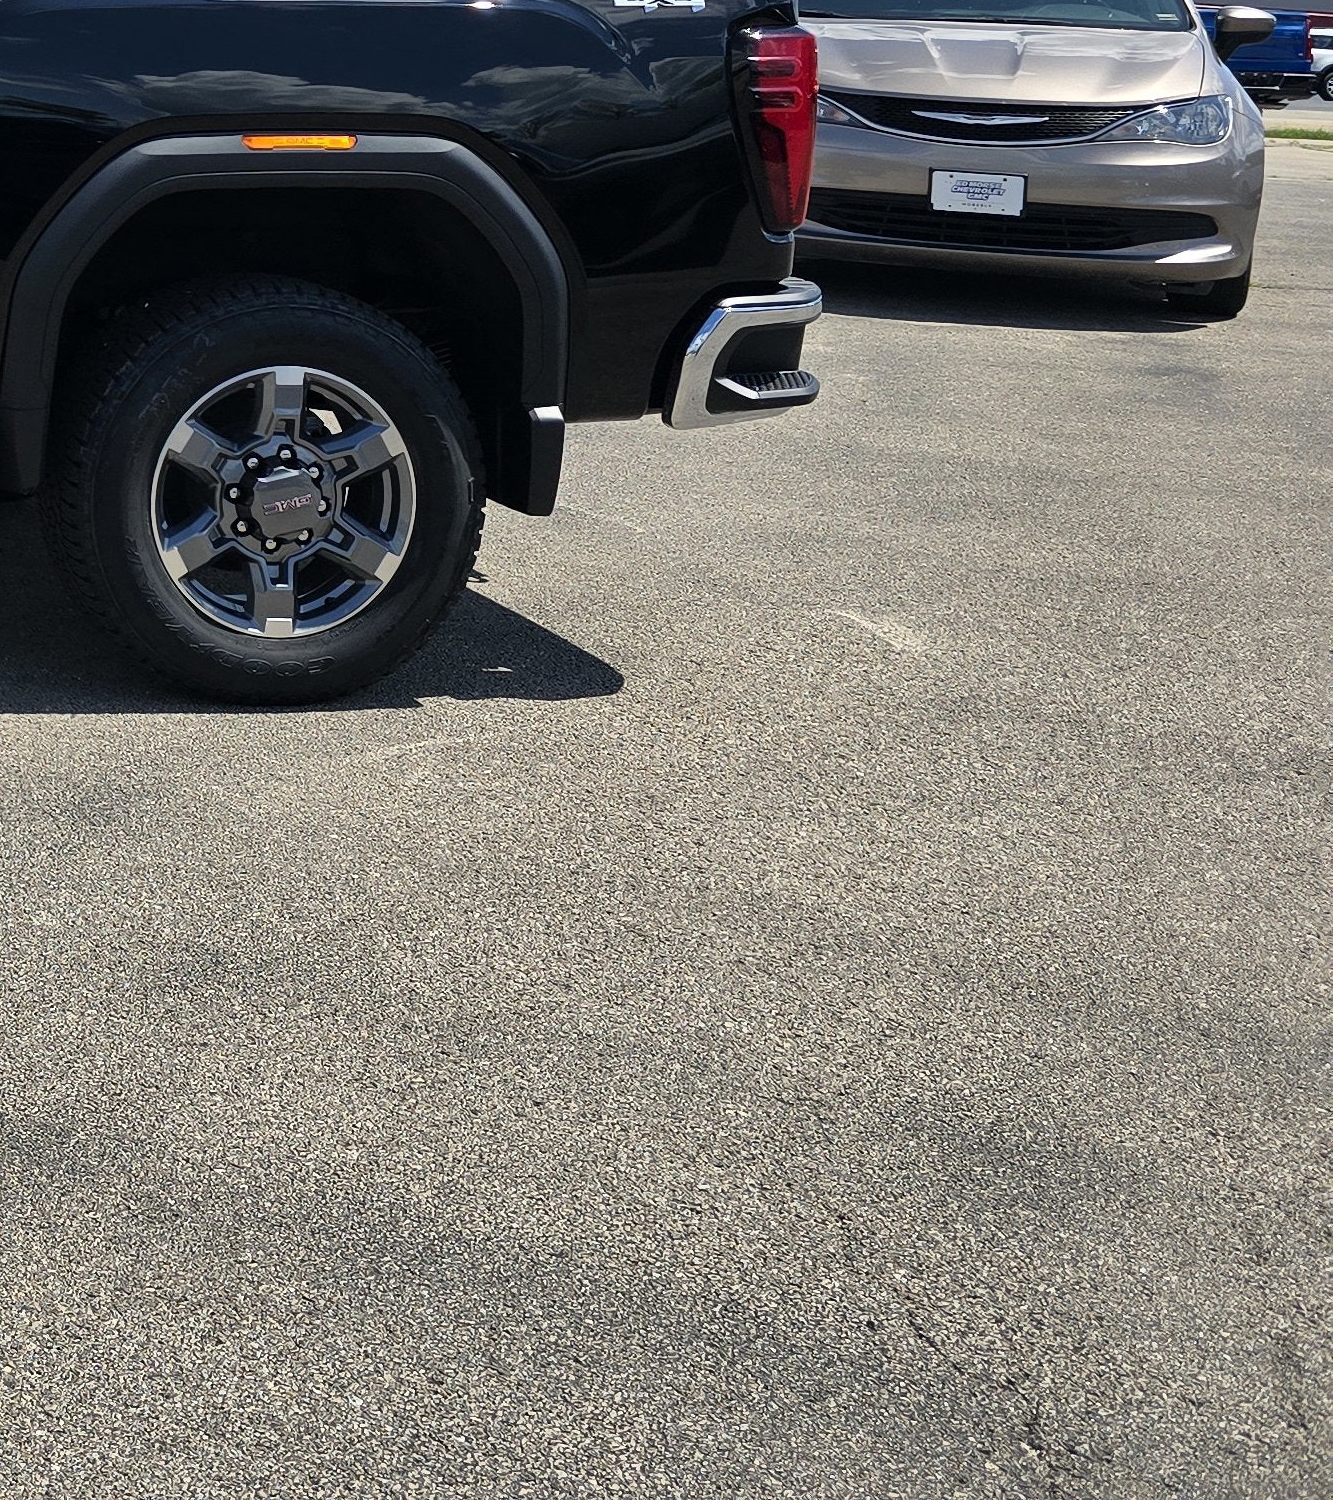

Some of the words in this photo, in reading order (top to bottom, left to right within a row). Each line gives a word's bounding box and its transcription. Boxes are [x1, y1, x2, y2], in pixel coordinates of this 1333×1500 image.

[969, 181, 1002, 189] MORSE
[951, 185, 1006, 196] CHEVROLET
[967, 193, 989, 201] GMC
[262, 493, 313, 516] GMC
